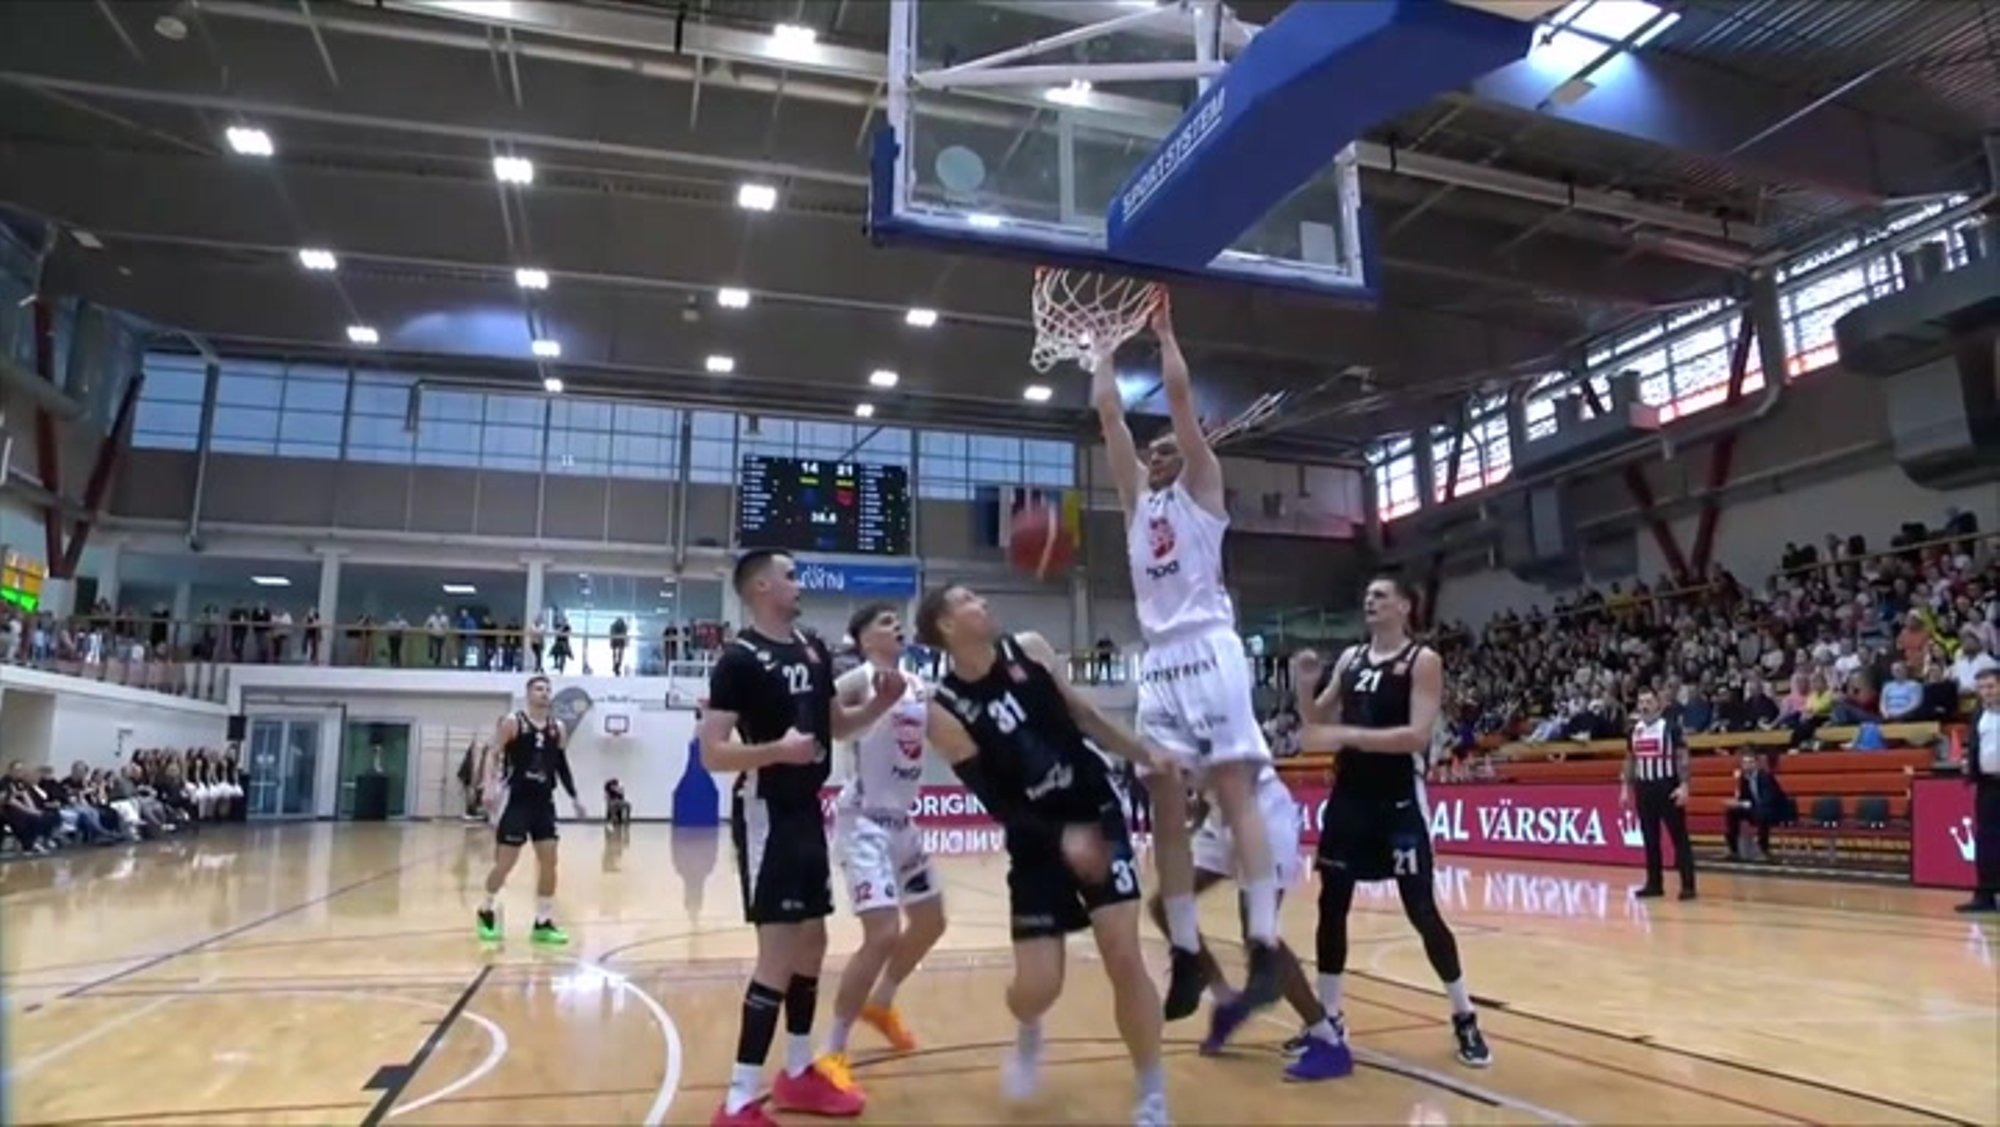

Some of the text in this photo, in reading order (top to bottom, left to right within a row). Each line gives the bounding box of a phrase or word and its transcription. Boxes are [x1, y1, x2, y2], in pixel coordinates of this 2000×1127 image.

[782, 662, 813, 694] 22
[1355, 668, 1383, 692] 21
[987, 691, 1027, 734] 31
[1477, 798, 1608, 846] VÄRSKA
[1393, 849, 1418, 875] 21
